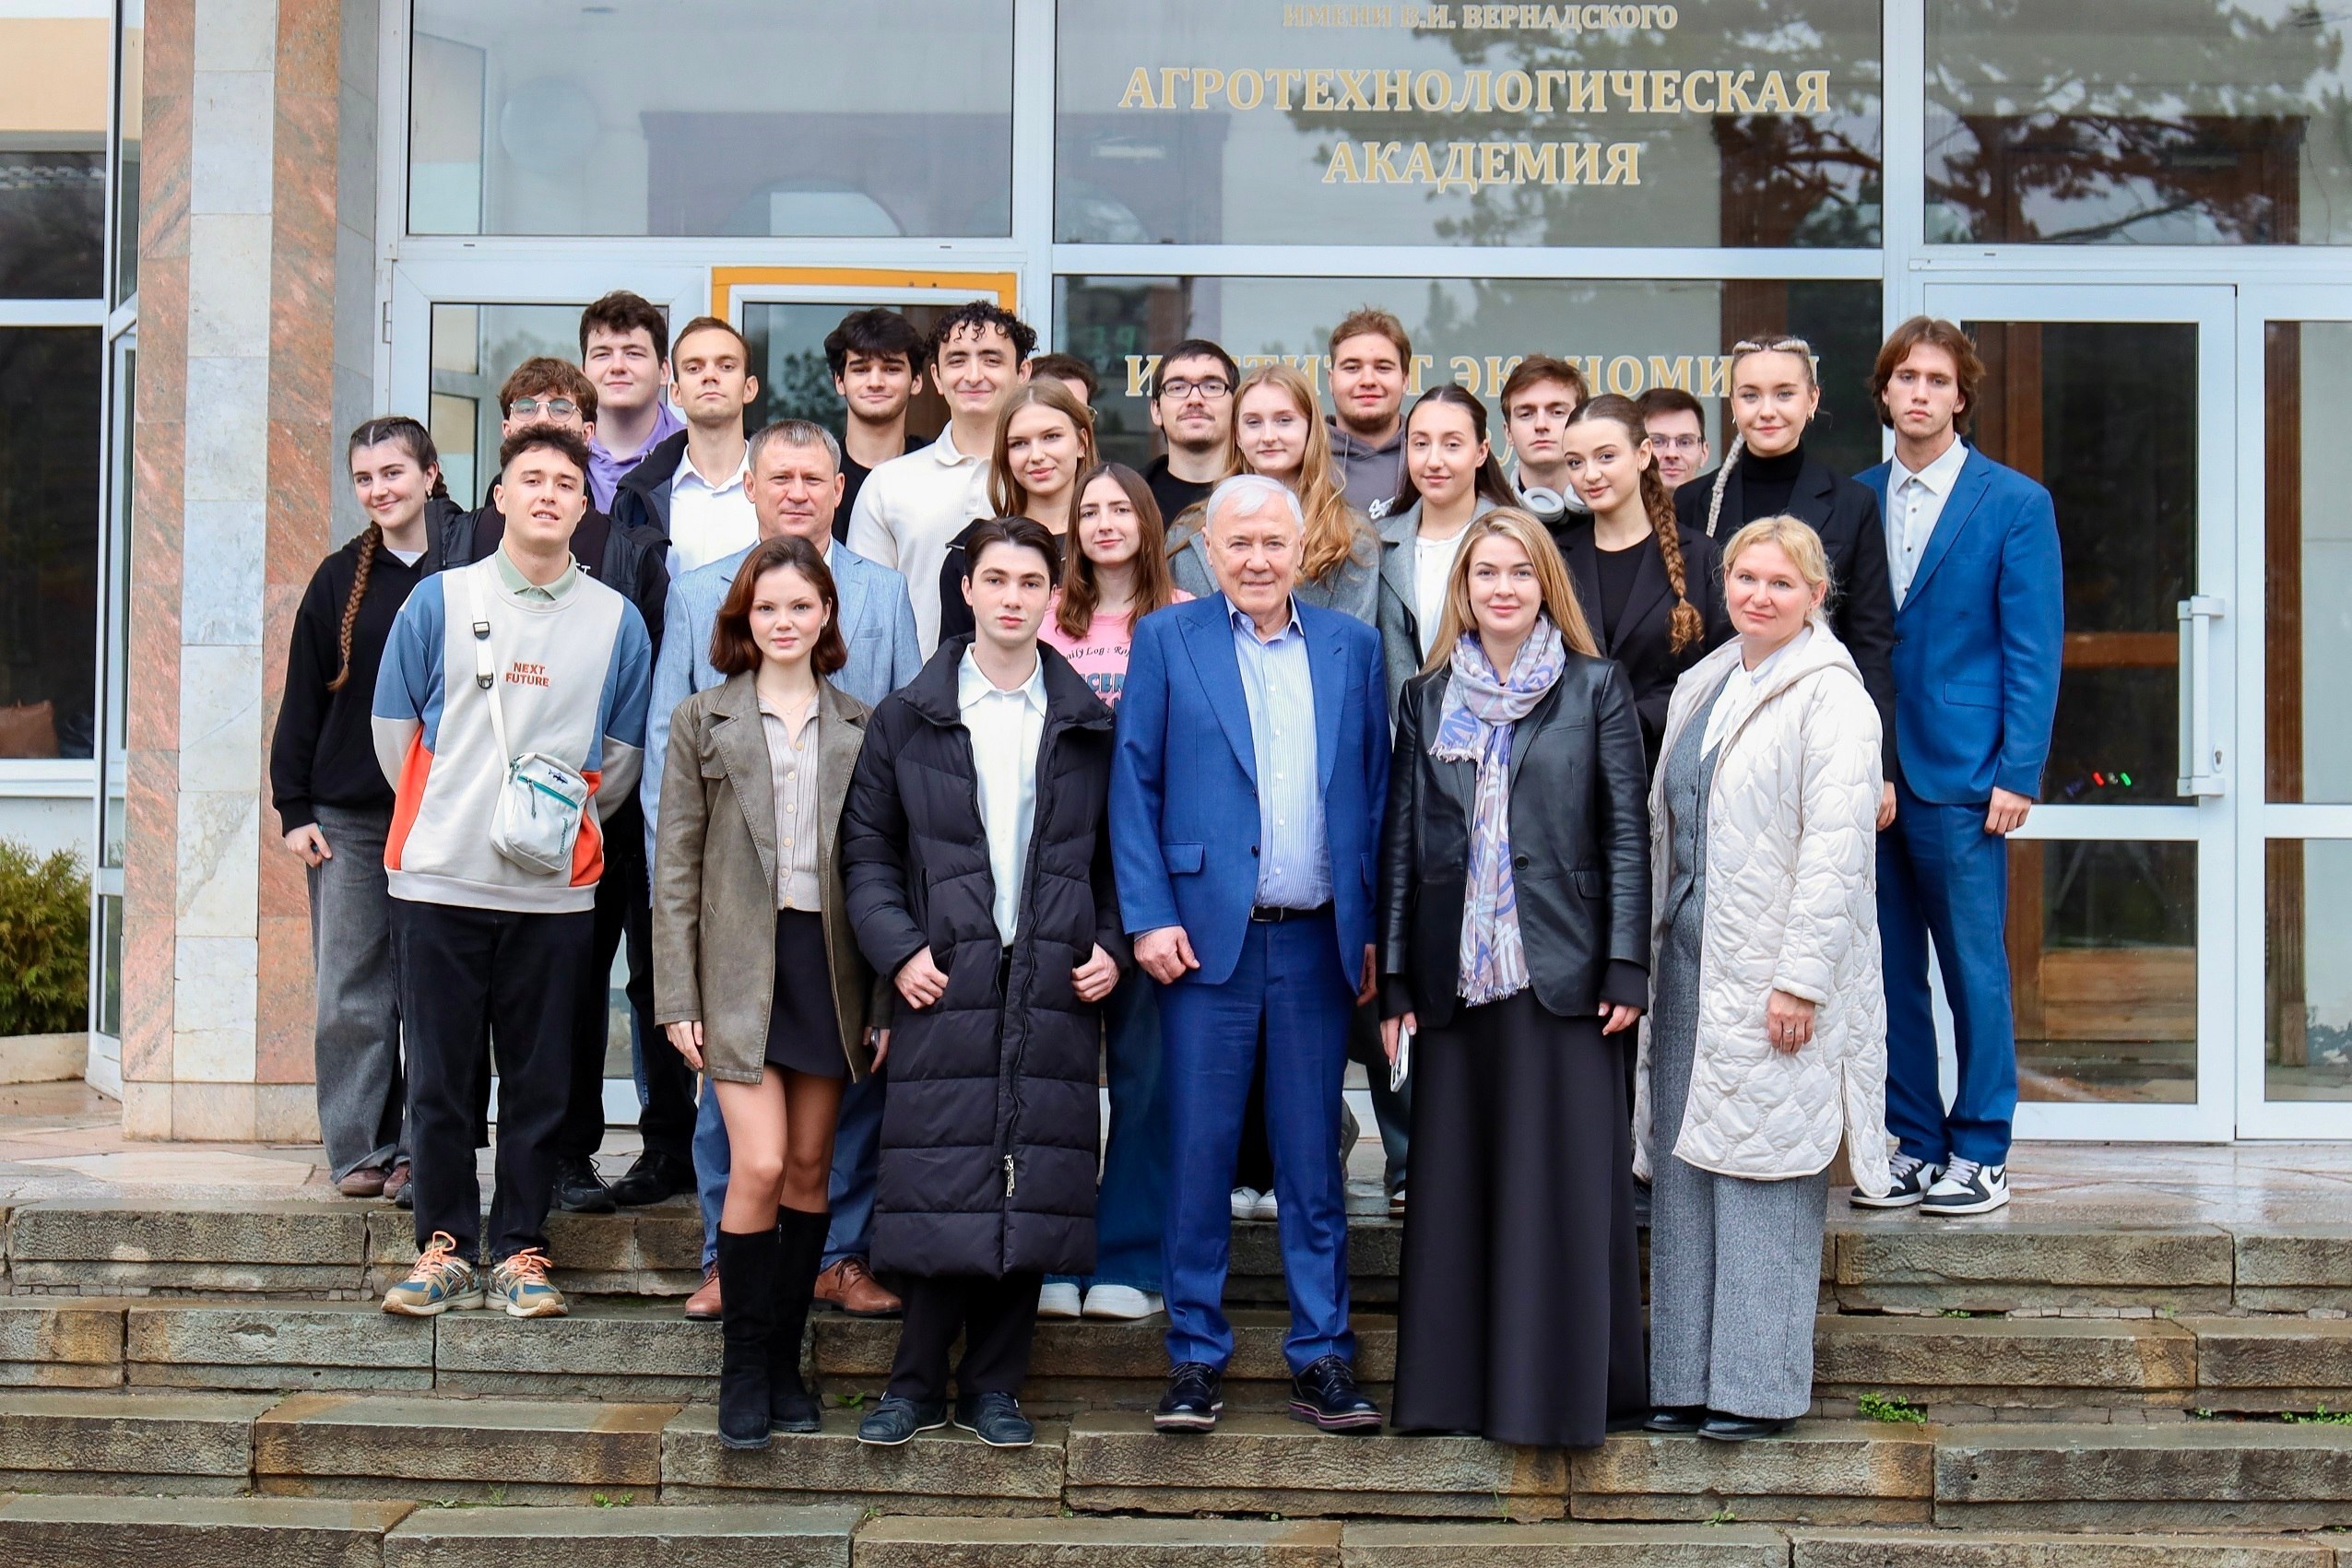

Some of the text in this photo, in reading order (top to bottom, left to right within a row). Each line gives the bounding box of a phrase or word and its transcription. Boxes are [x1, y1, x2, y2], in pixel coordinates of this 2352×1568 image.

[1282, 4, 1679, 34] ИМЕНИ В.И. ВЕРНАДСКОГО
[1117, 66, 1831, 114] АГРОТЕХНОЛОГИЧЕСКАЯ
[1321, 141, 1641, 194] АКАДЕМИЯ
[504, 672, 550, 688] FUTURE
[513, 662, 546, 675] NEXT
